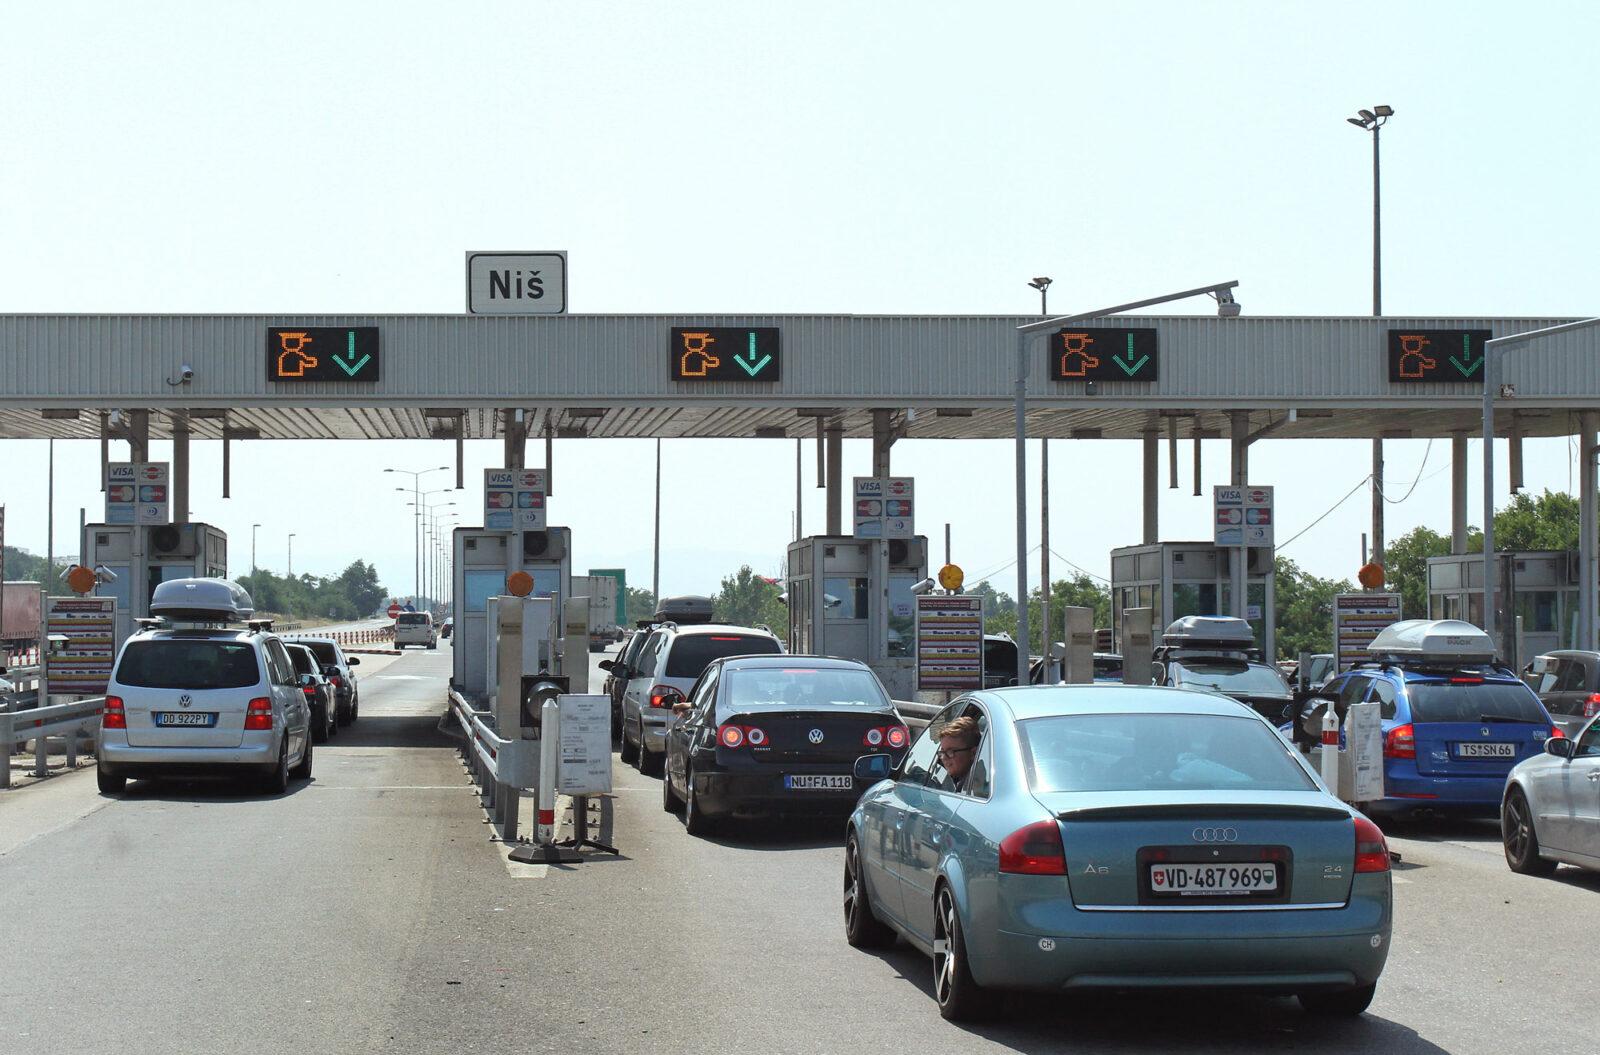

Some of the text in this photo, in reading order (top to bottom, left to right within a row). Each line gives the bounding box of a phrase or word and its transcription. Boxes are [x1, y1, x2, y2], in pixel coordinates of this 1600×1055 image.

[489, 270, 544, 300] Niš
[112, 467, 134, 476] VISA
[491, 473, 513, 483] VISA
[860, 482, 881, 491] VISA
[1221, 490, 1242, 499] VISA
[1085, 863, 1109, 873] A6
[1041, 940, 1053, 949] CH
